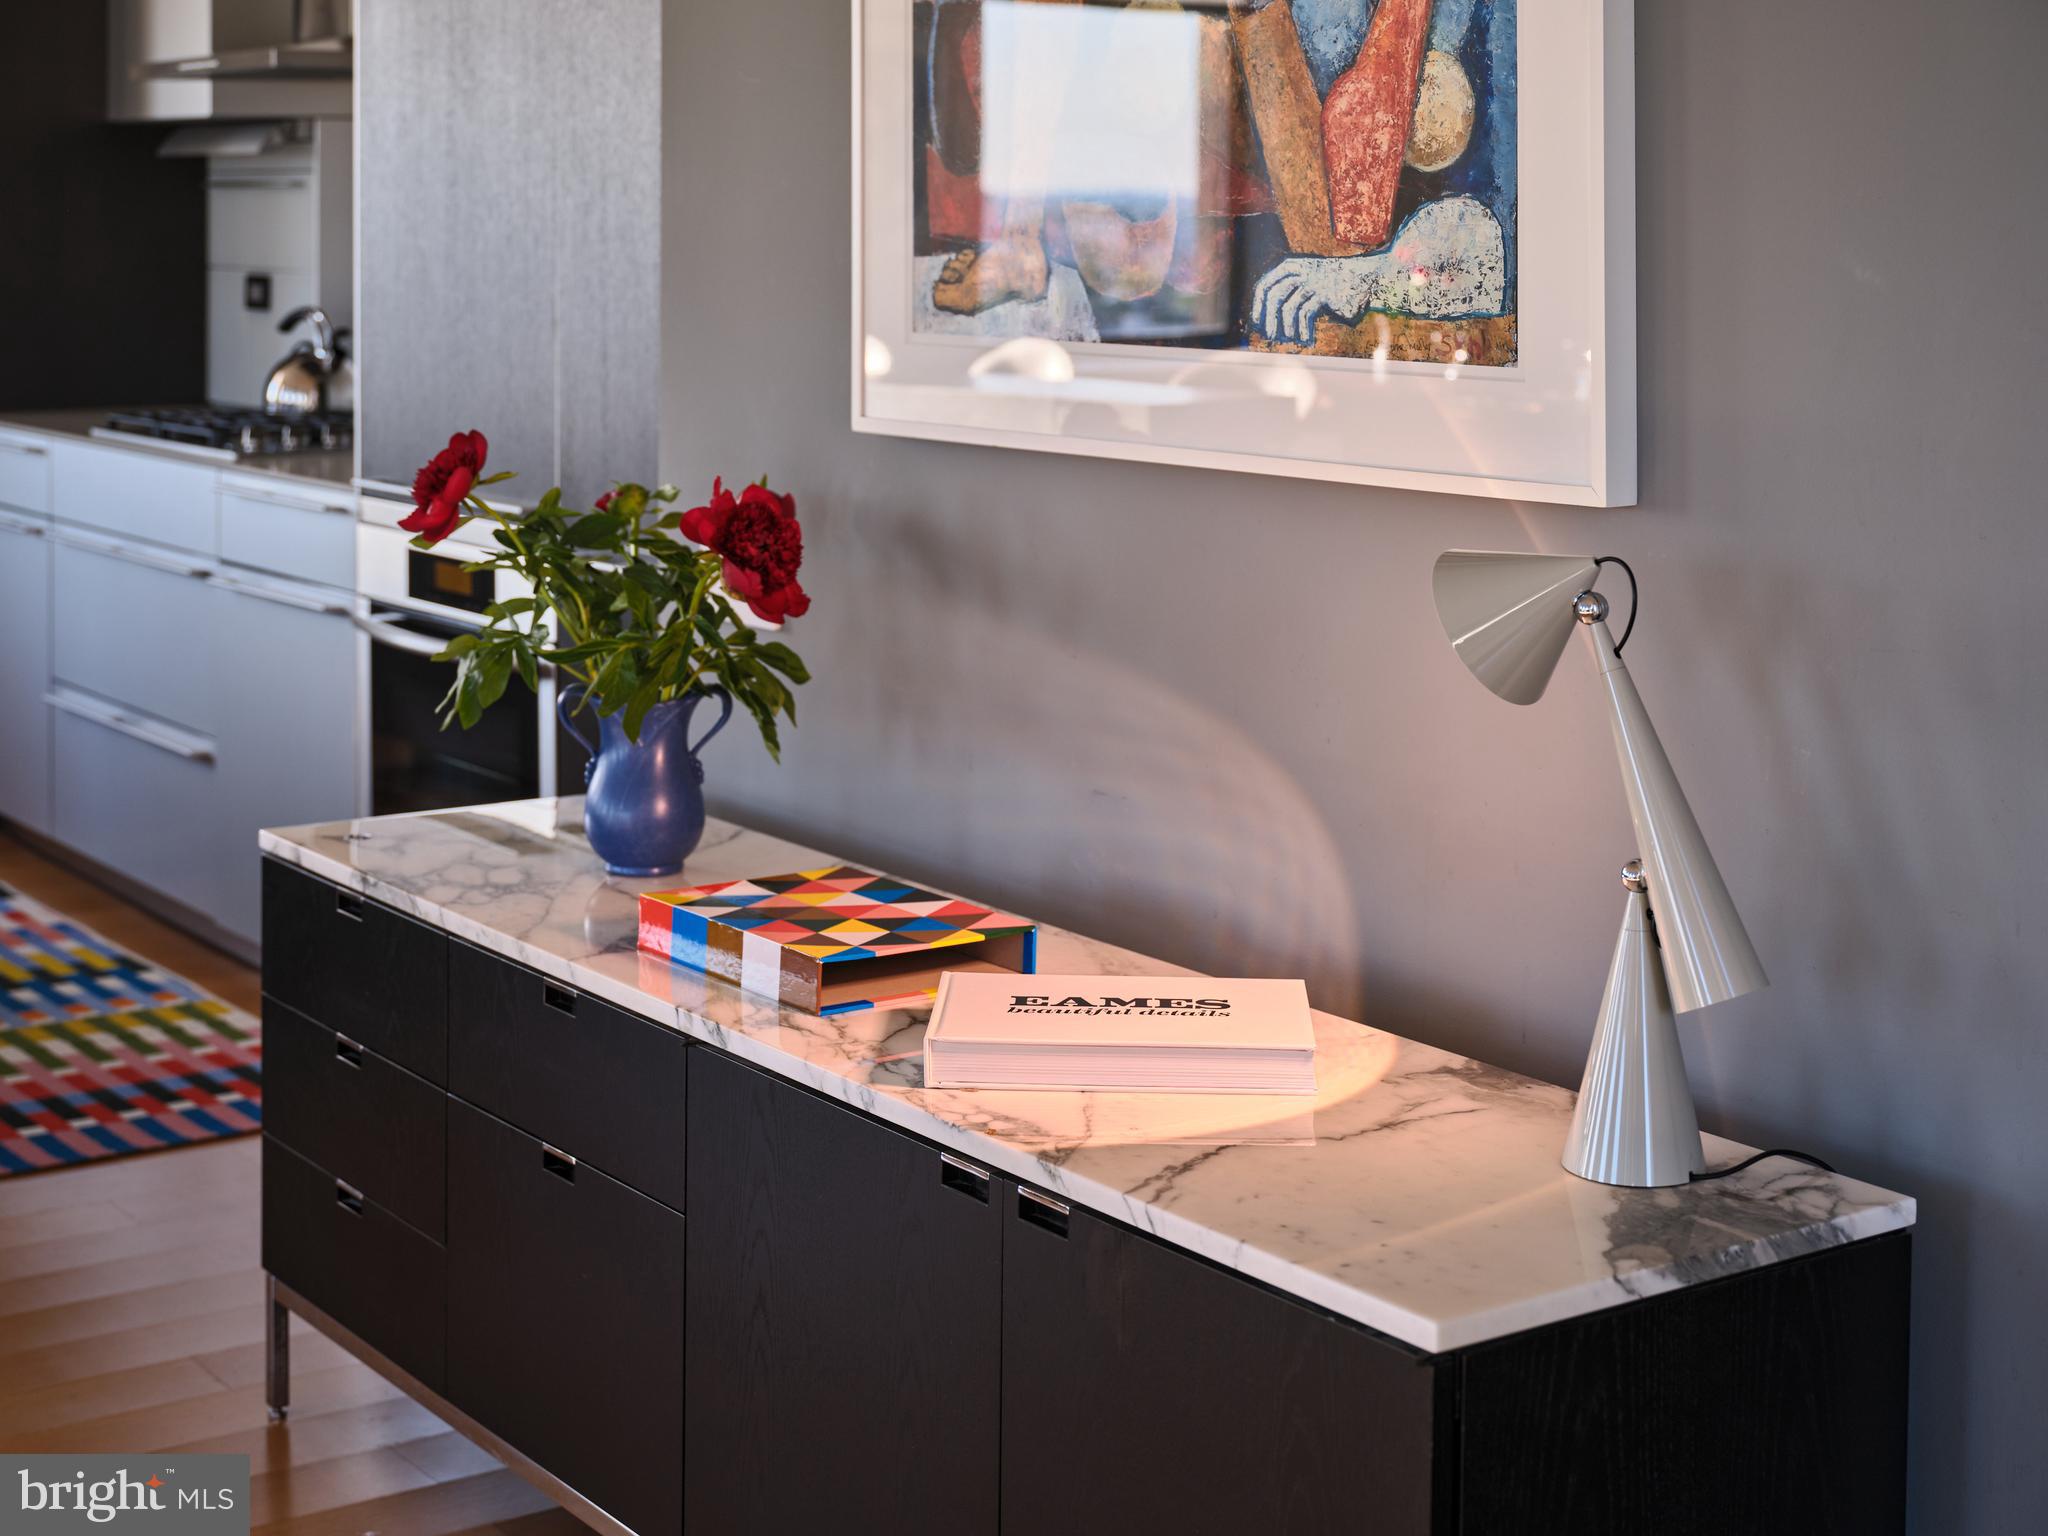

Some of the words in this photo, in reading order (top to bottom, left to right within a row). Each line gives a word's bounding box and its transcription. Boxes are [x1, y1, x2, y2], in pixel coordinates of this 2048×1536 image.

[1009, 995, 1231, 1010] EAMES
[1007, 1006, 1132, 1017] beautiful
[1139, 1008, 1231, 1017] details
